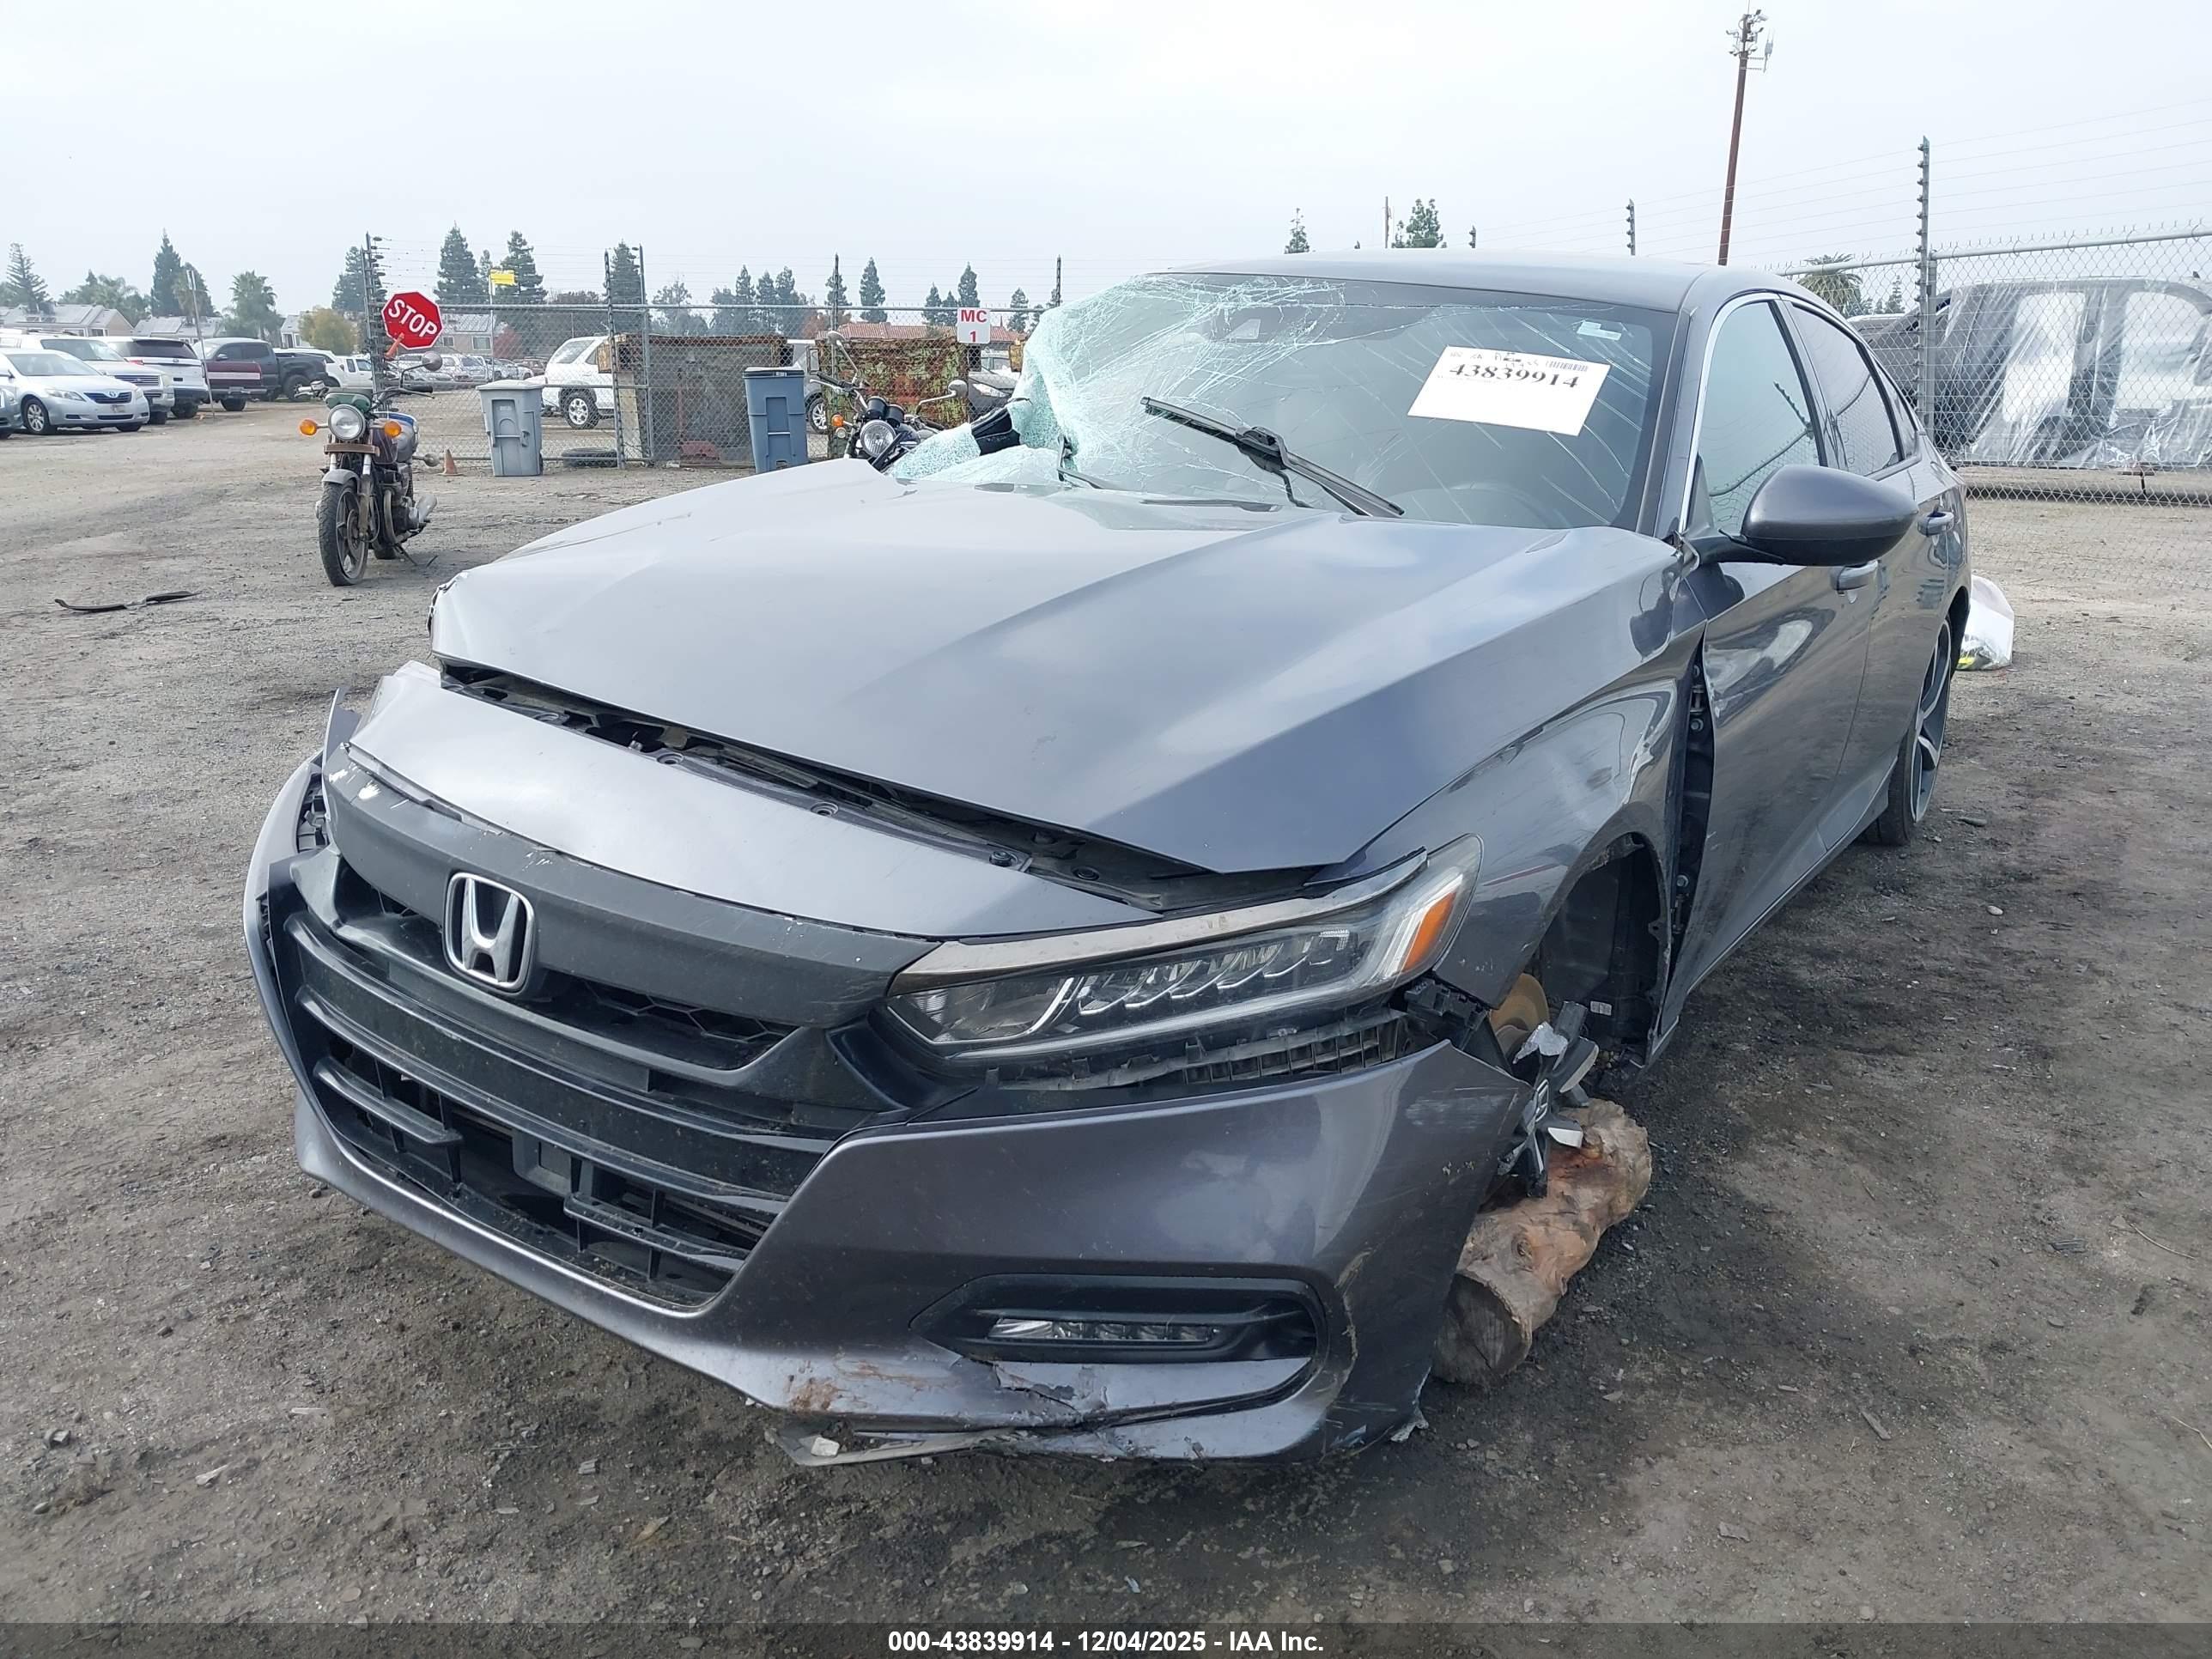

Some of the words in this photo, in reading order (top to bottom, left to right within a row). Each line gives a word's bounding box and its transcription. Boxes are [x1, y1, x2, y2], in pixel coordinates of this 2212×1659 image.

[388, 299, 438, 337] STOP
[961, 309, 988, 323] MC
[969, 331, 976, 343] 1
[1449, 363, 1579, 388] 43839914
